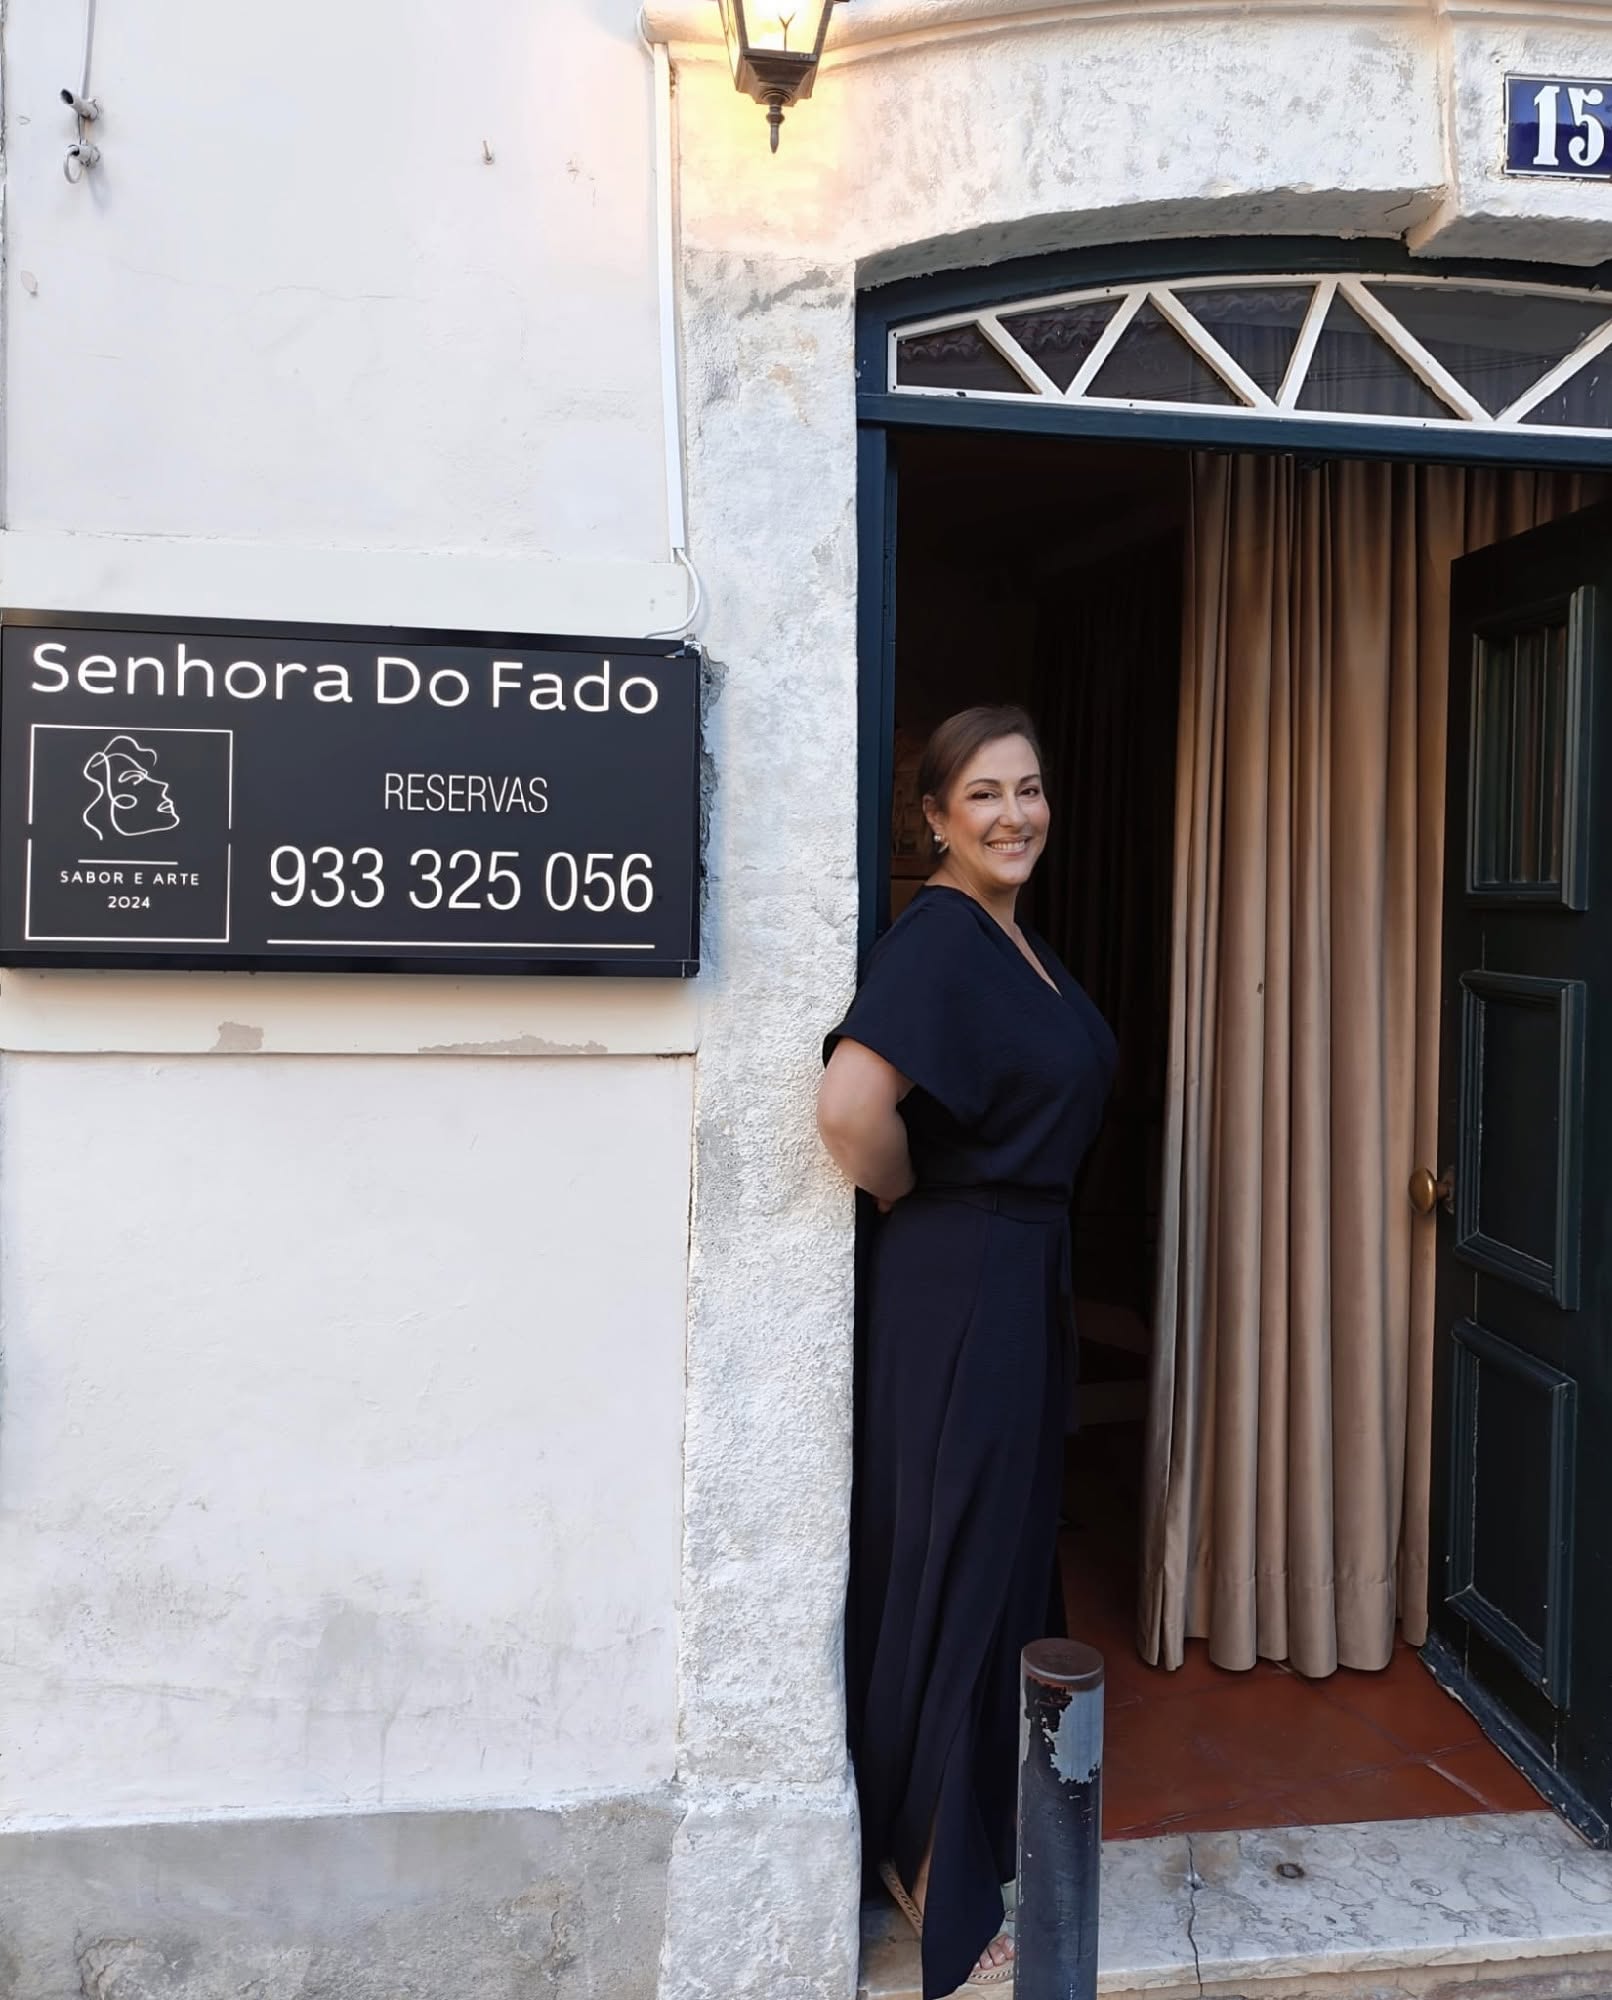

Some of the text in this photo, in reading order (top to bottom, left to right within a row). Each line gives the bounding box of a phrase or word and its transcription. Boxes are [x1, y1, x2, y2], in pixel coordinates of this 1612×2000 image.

[1533, 86, 1605, 166] 15
[32, 643, 658, 714] Senhora Do Fado
[385, 773, 548, 813] RESERVAS
[60, 871, 200, 886] SABOR E ARTE
[107, 895, 151, 909] 2024
[270, 846, 654, 912] 933 325 056
